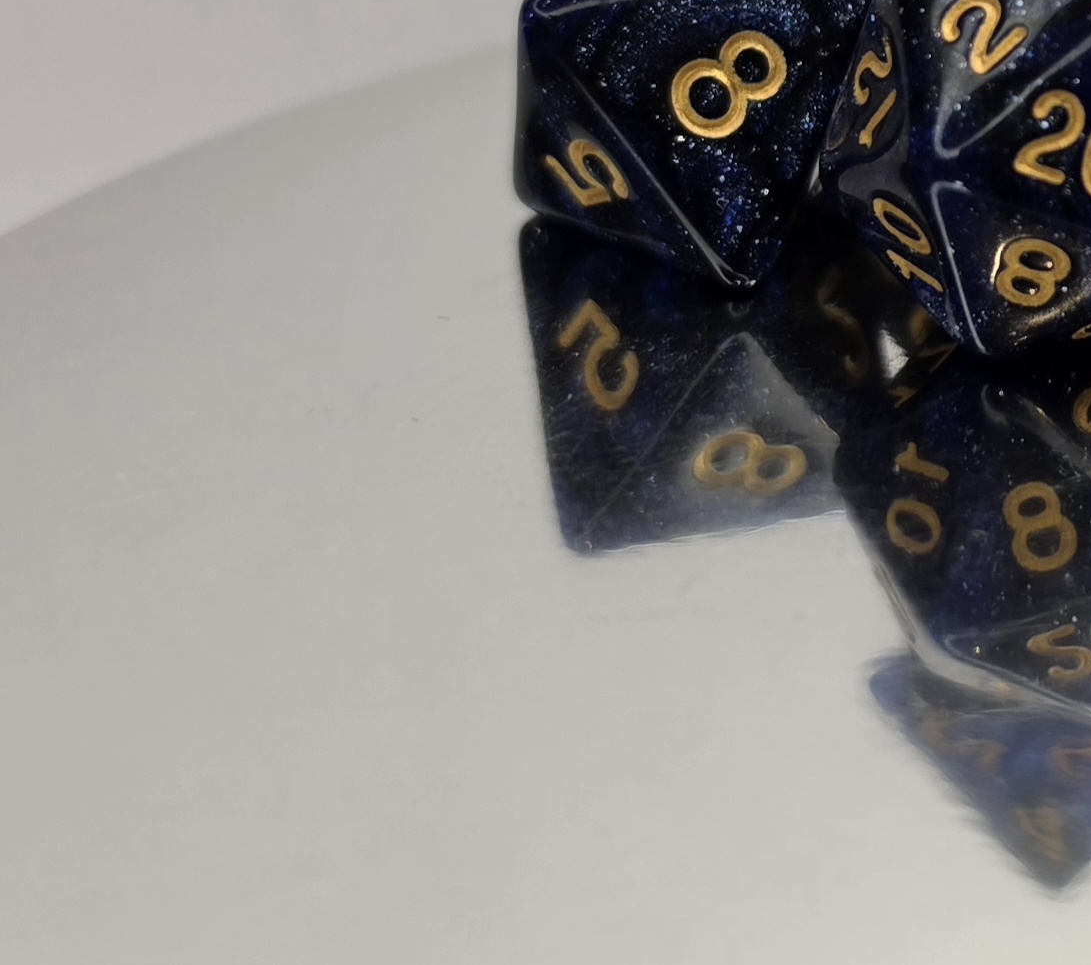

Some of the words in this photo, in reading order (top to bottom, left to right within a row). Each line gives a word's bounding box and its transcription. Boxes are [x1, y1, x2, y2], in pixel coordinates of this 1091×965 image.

[670, 30, 788, 140] 8
[545, 137, 630, 208] 5
[871, 196, 944, 293] 10
[992, 237, 1072, 308] 8
